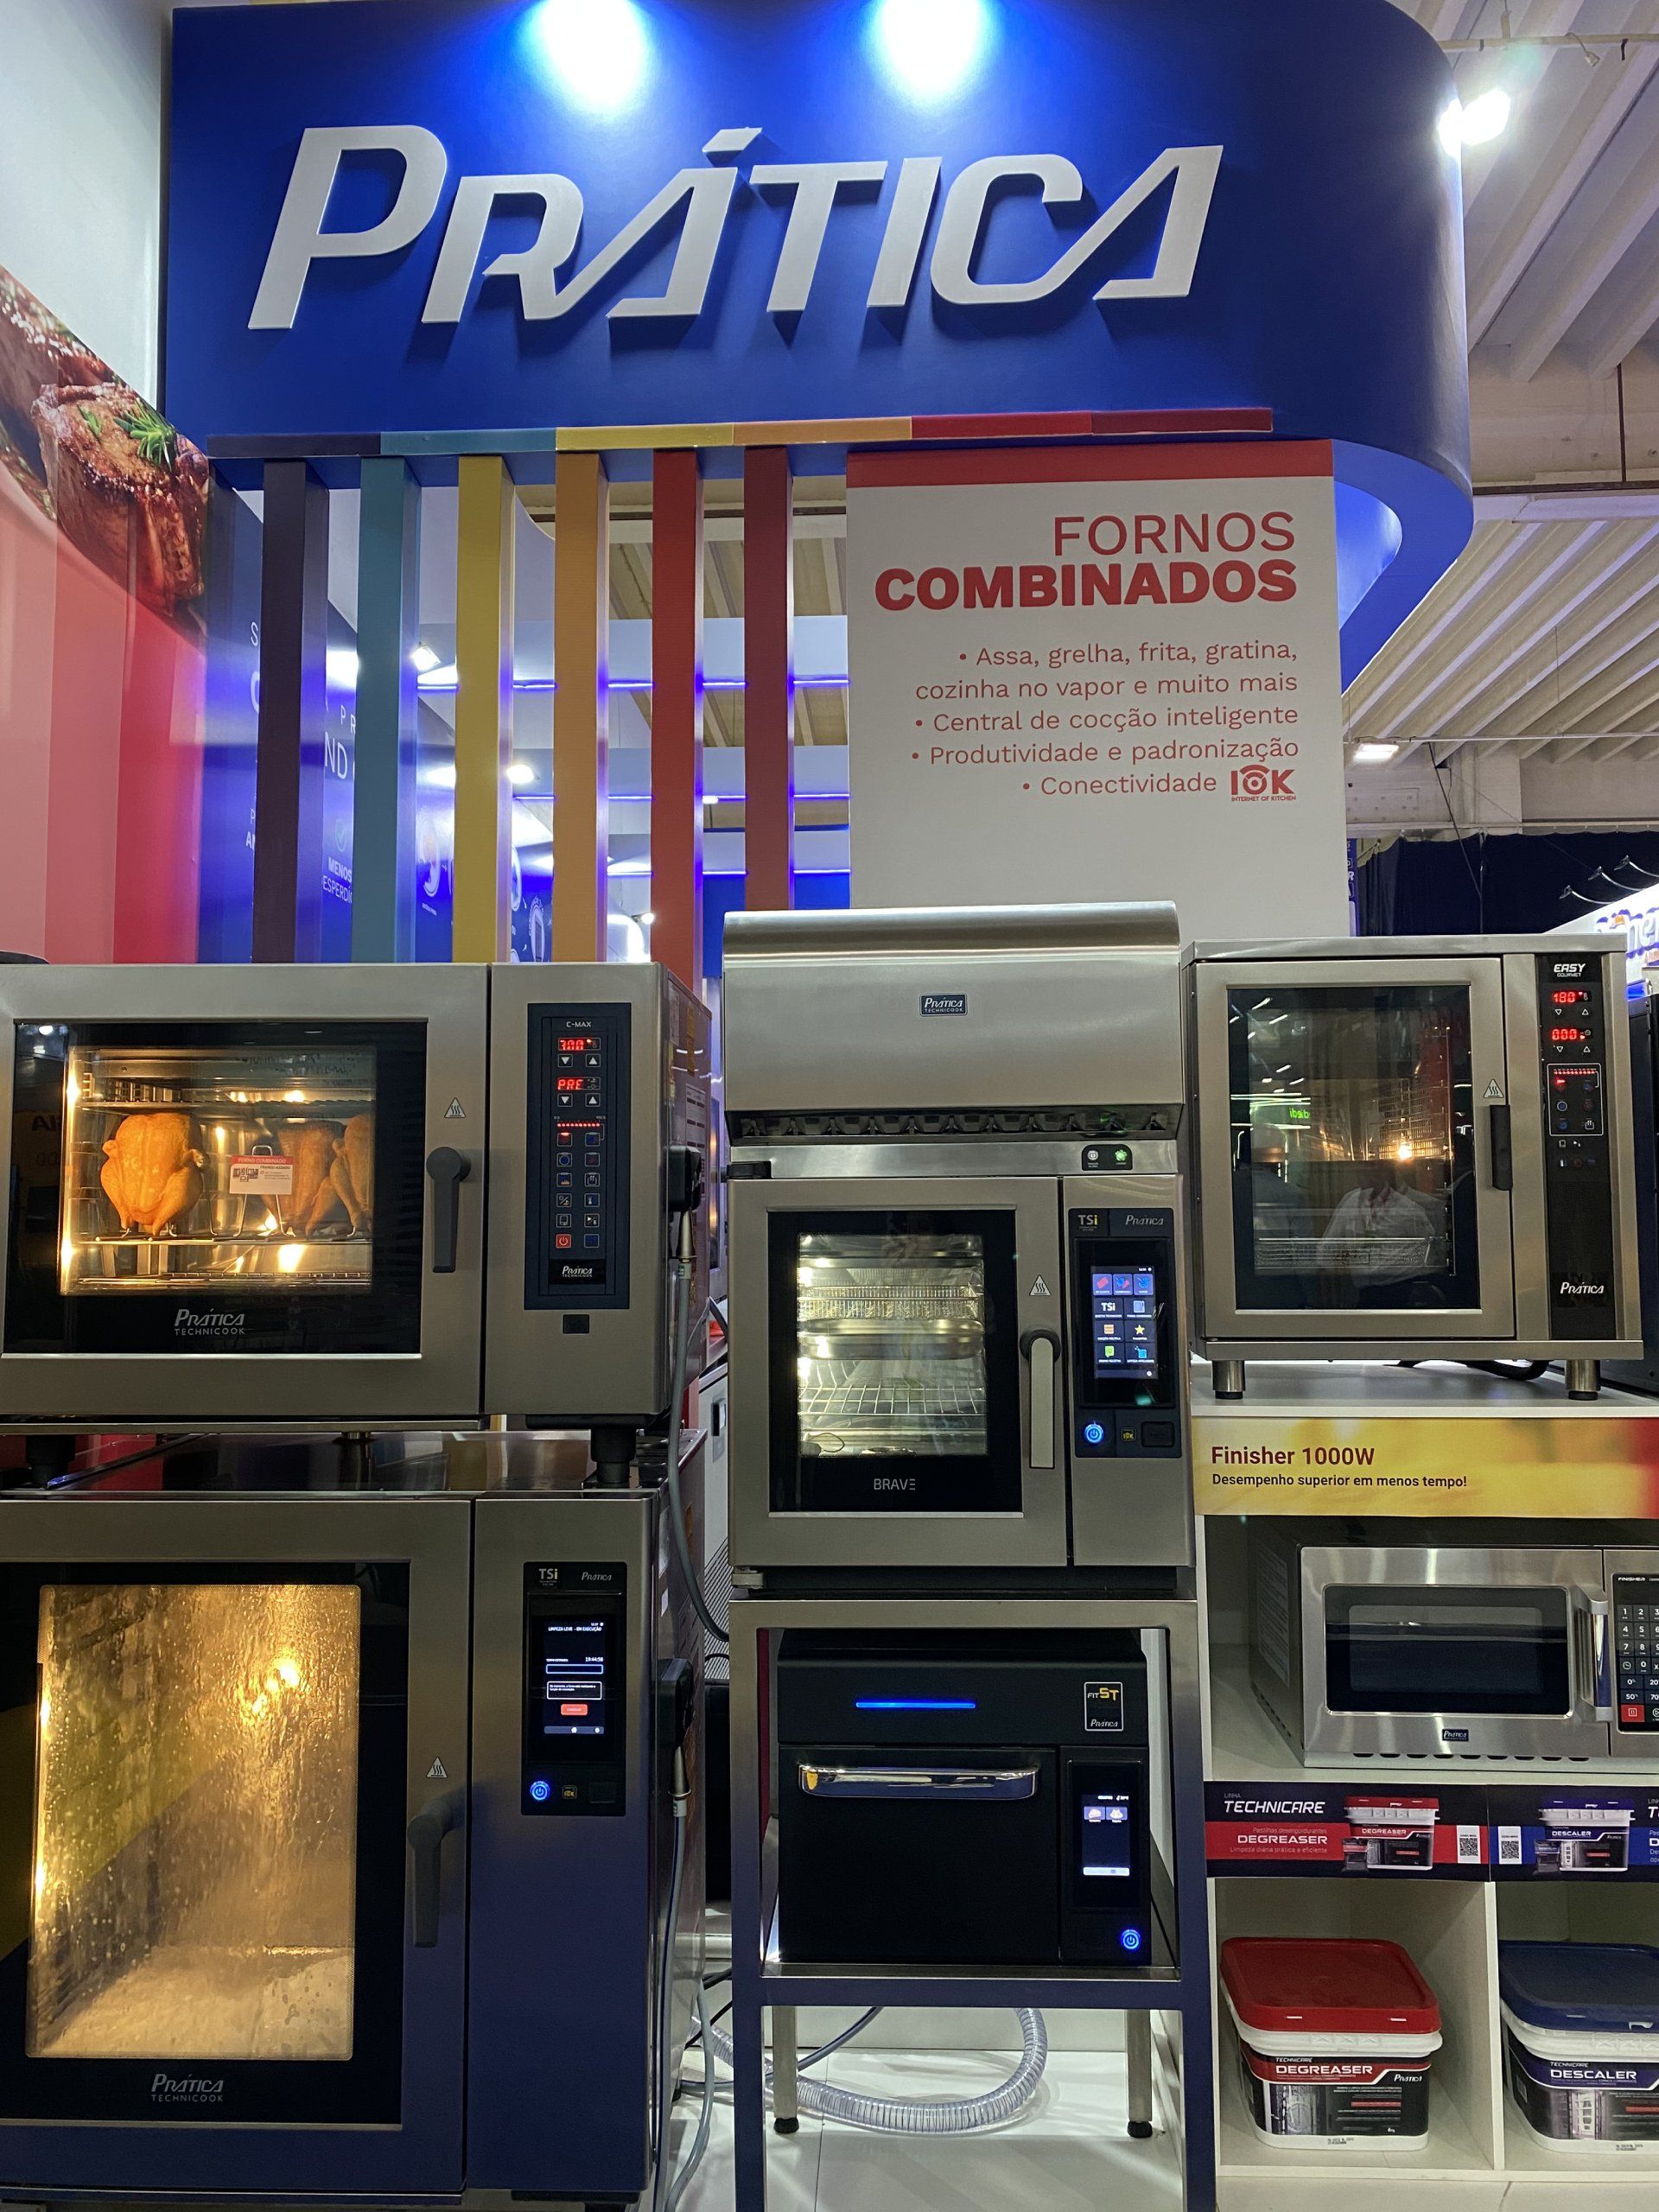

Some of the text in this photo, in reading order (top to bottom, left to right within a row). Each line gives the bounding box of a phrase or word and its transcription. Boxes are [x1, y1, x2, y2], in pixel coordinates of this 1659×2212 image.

[247, 124, 1224, 329] PRÁTICA
[1053, 511, 1295, 556] FORNOS
[874, 558, 1297, 611] COMBINADOS
[976, 639, 1298, 669] Assa, grelha, frita, gratina,
[915, 671, 1298, 701] cozinha no vapor e muito mais
[933, 705, 1299, 733] Central de cocção inteligente
[931, 737, 1300, 766] Produtividade e padronização
[1040, 772, 1217, 795] Conectividade
[1553, 963, 1586, 974] EASY
[924, 996, 963, 1008] PRÁTICA
[1077, 1214, 1098, 1226] TSi
[1560, 1281, 1605, 1294] PRÁTICA
[174, 1307, 245, 1326] PRÁTICA
[174, 1327, 245, 1336] TECHNICOOK
[1211, 1446, 1376, 1465] Finisher 1000W
[874, 1478, 916, 1491] BRAVE
[1211, 1473, 1468, 1490] Desempenho superior em menos tempo!
[538, 1567, 558, 1580] TSi
[1637, 1607, 1643, 1616] 2
[1224, 1800, 1326, 1814] TECHNICARE
[1237, 1834, 1328, 1845] DEGREASER
[1275, 2065, 1373, 2075] DEGREASER
[1550, 2069, 1637, 2080] DESCALER
[150, 2073, 224, 2092] PRÁTICA
[150, 2094, 224, 2102] TECHNICOOK
